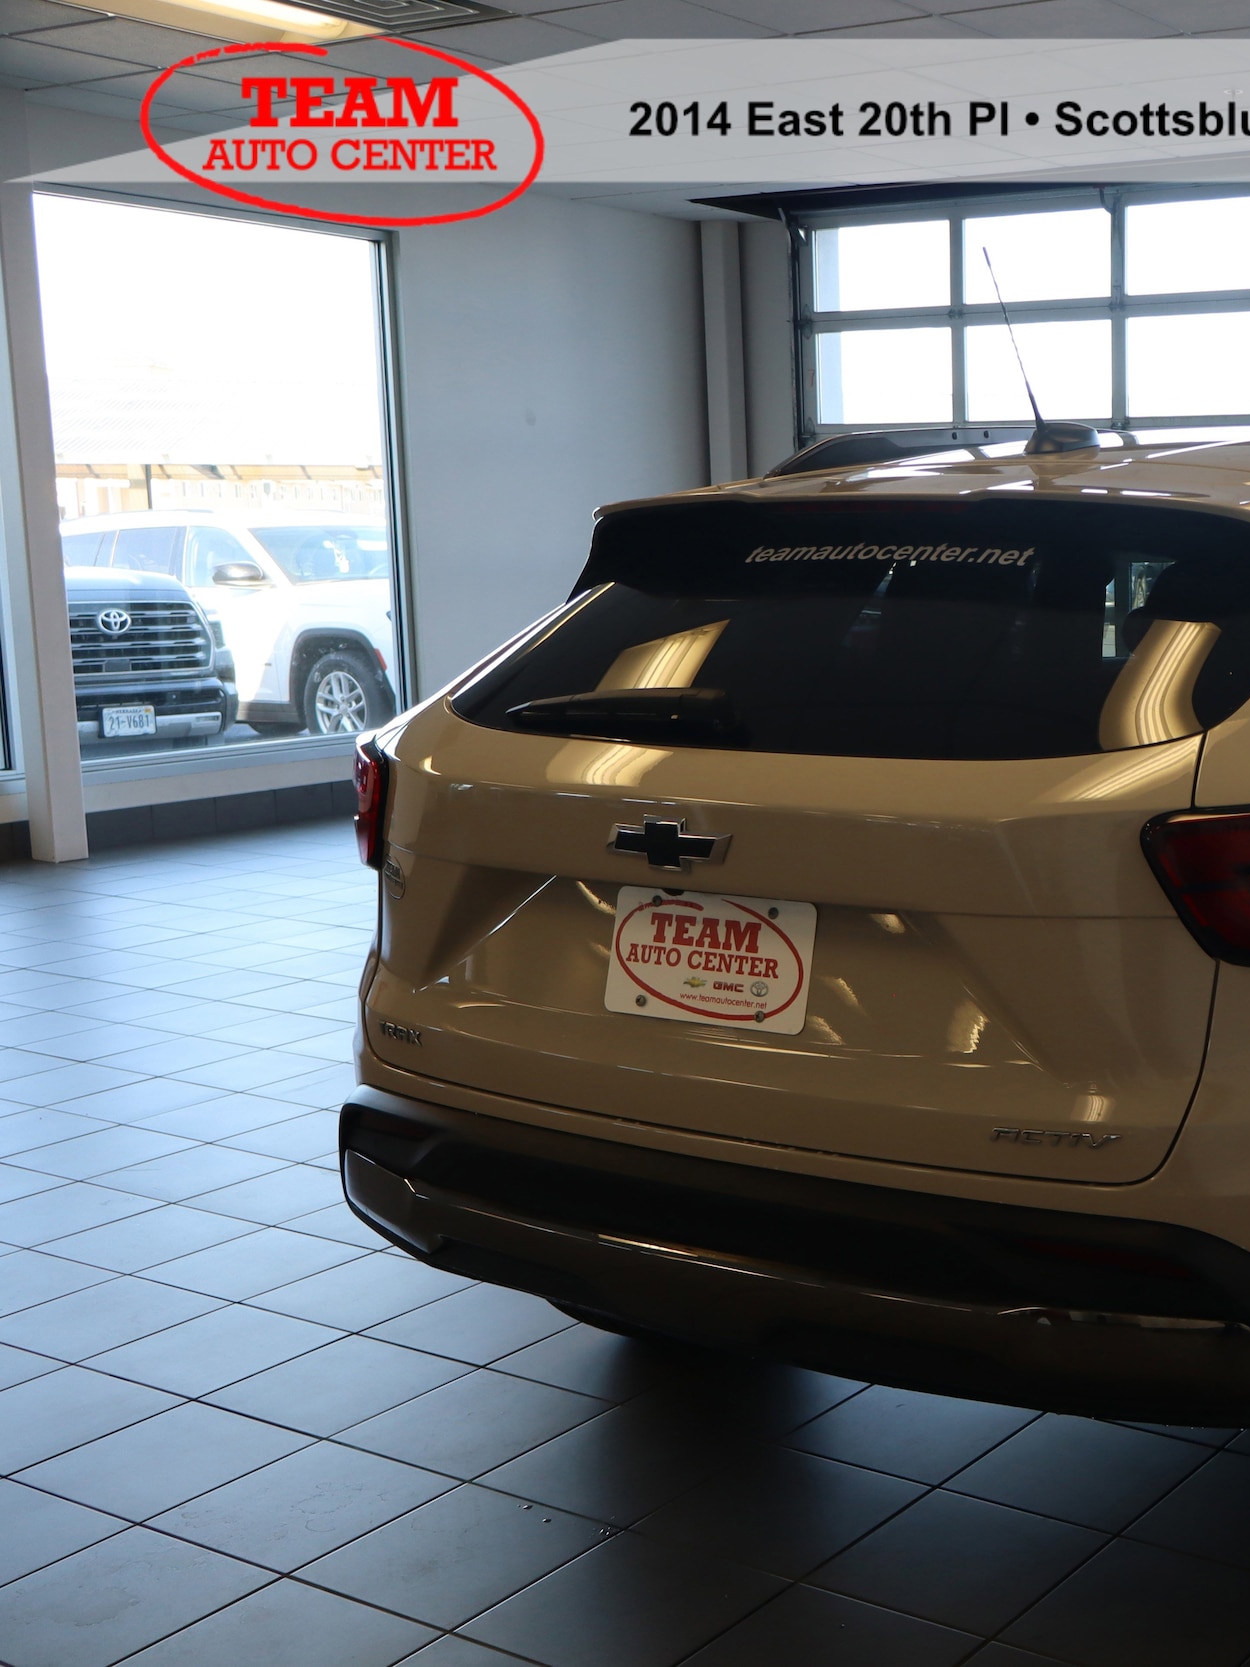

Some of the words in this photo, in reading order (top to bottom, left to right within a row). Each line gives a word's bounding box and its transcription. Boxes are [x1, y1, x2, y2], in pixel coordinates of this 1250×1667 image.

[745, 541, 1036, 568] teamautocenter.net
[109, 713, 150, 731] 21-V681
[651, 912, 762, 953] TEAM
[626, 943, 682, 968] AUTO
[687, 950, 779, 979] CENTER
[713, 981, 744, 992] GMC
[680, 992, 768, 1010] www.teamautocenter.net
